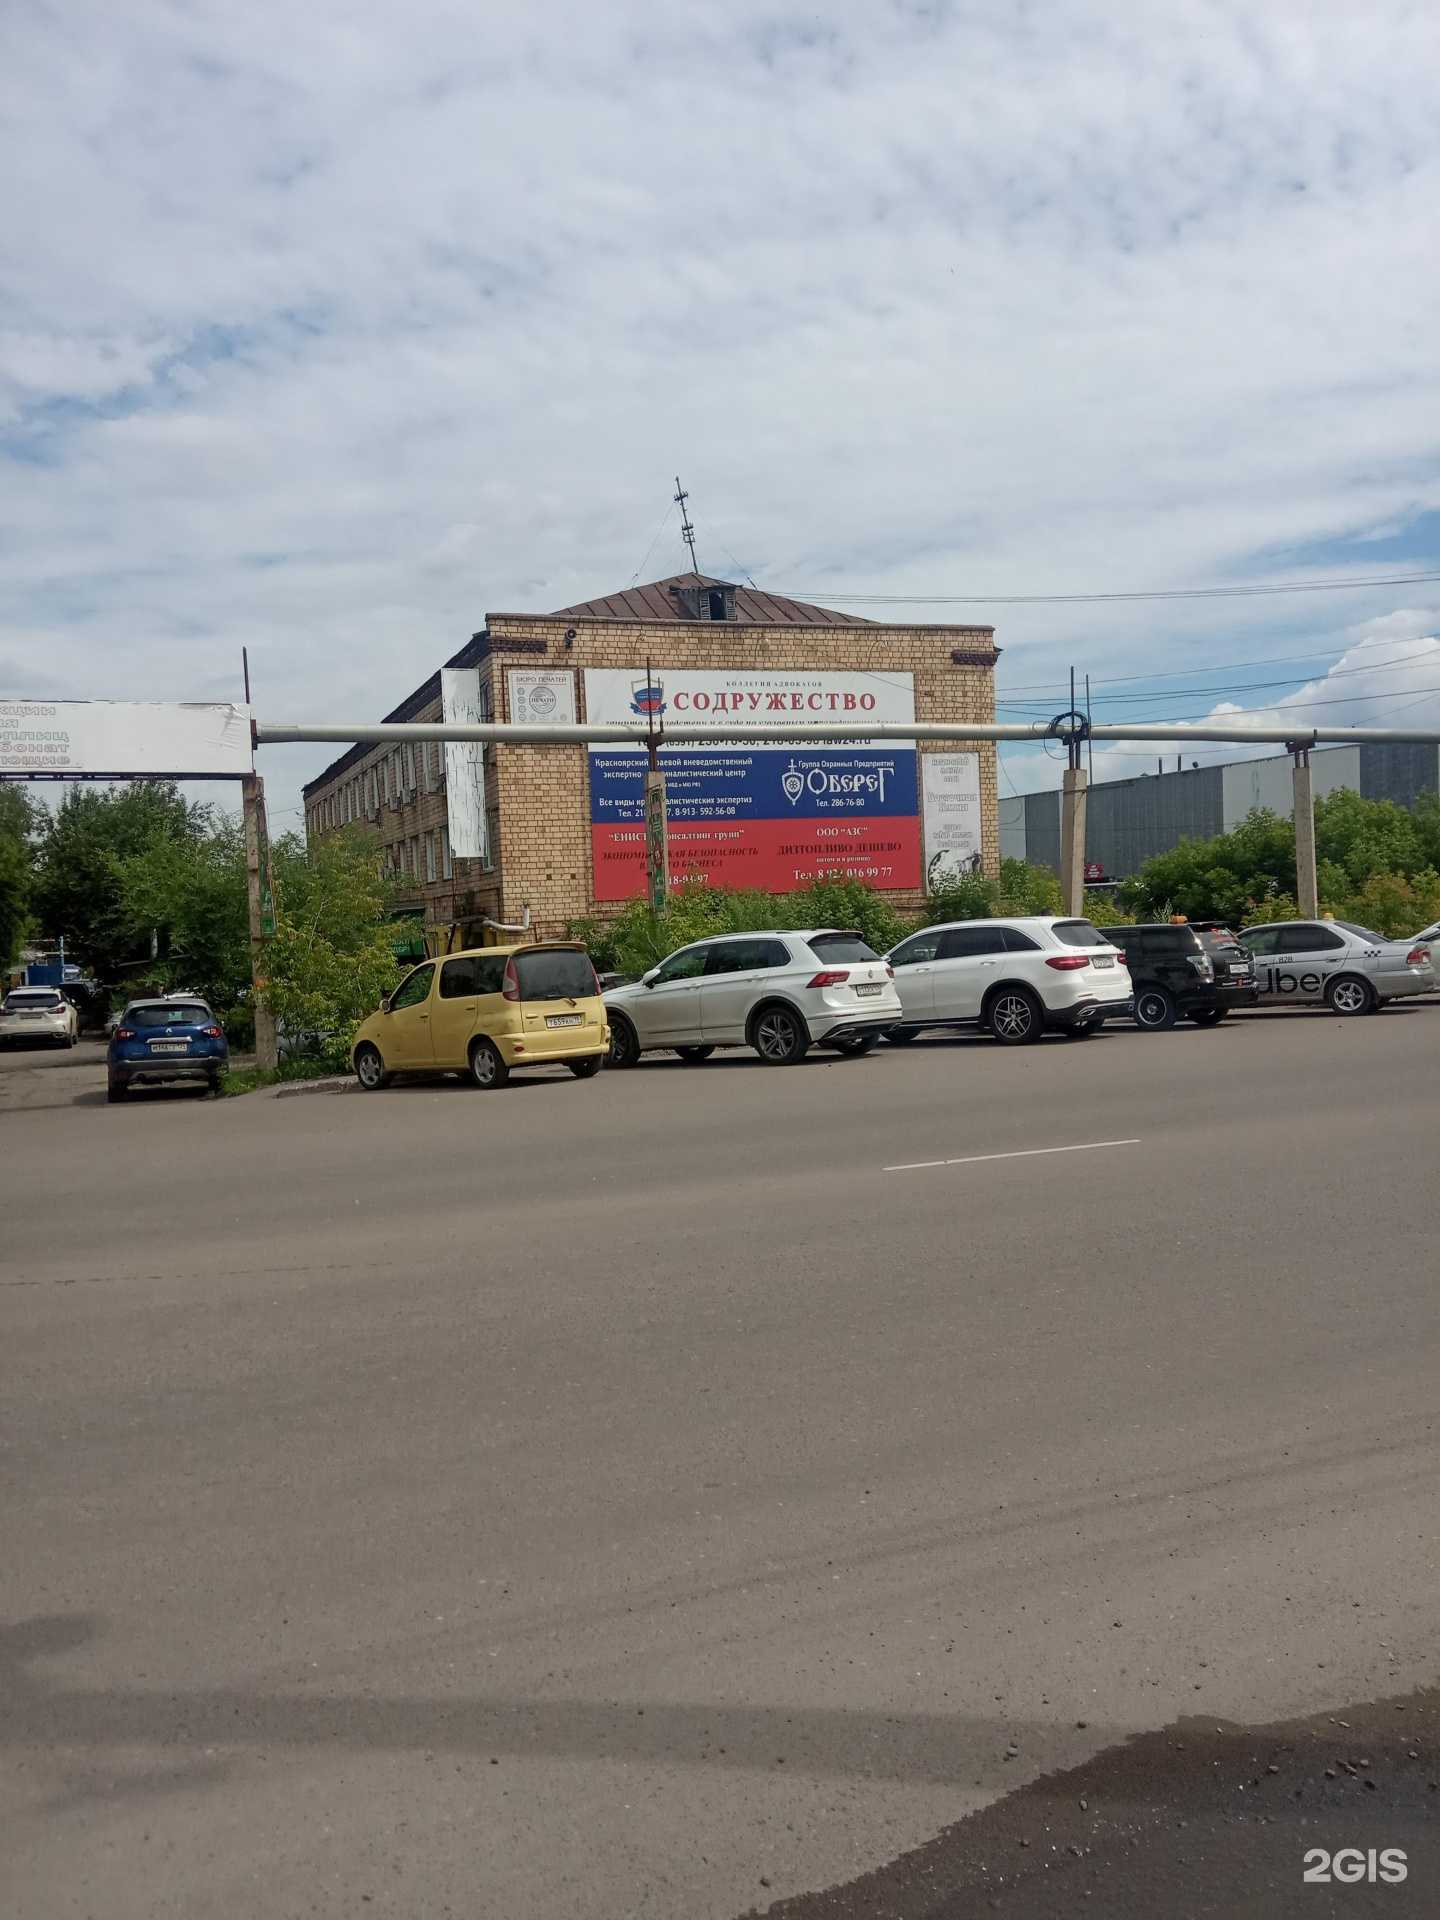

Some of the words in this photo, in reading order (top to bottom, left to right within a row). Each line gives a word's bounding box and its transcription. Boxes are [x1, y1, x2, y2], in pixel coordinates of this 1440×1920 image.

[673, 692, 876, 715] СОДРУЖЕСТВО
[595, 758, 649, 770] Красноярский
[656, 757, 682, 767] раевой
[683, 757, 753, 768] вневедомственный
[798, 760, 820, 769] Группа
[853, 759, 895, 769] Предприятий
[724, 769, 746, 779] центр
[599, 797, 613, 807] Все
[614, 799, 634, 808] виды
[716, 796, 752, 806] экспертиз
[815, 799, 830, 807] Тел.
[831, 798, 865, 807] 286-76-80
[816, 827, 839, 837] ООО
[777, 843, 853, 855] ДИЗТОПЛИВО
[855, 842, 902, 853] ДЕШЕВО
[817, 869, 824, 879] 8
[866, 867, 878, 877] 99
[880, 866, 893, 877] 77
